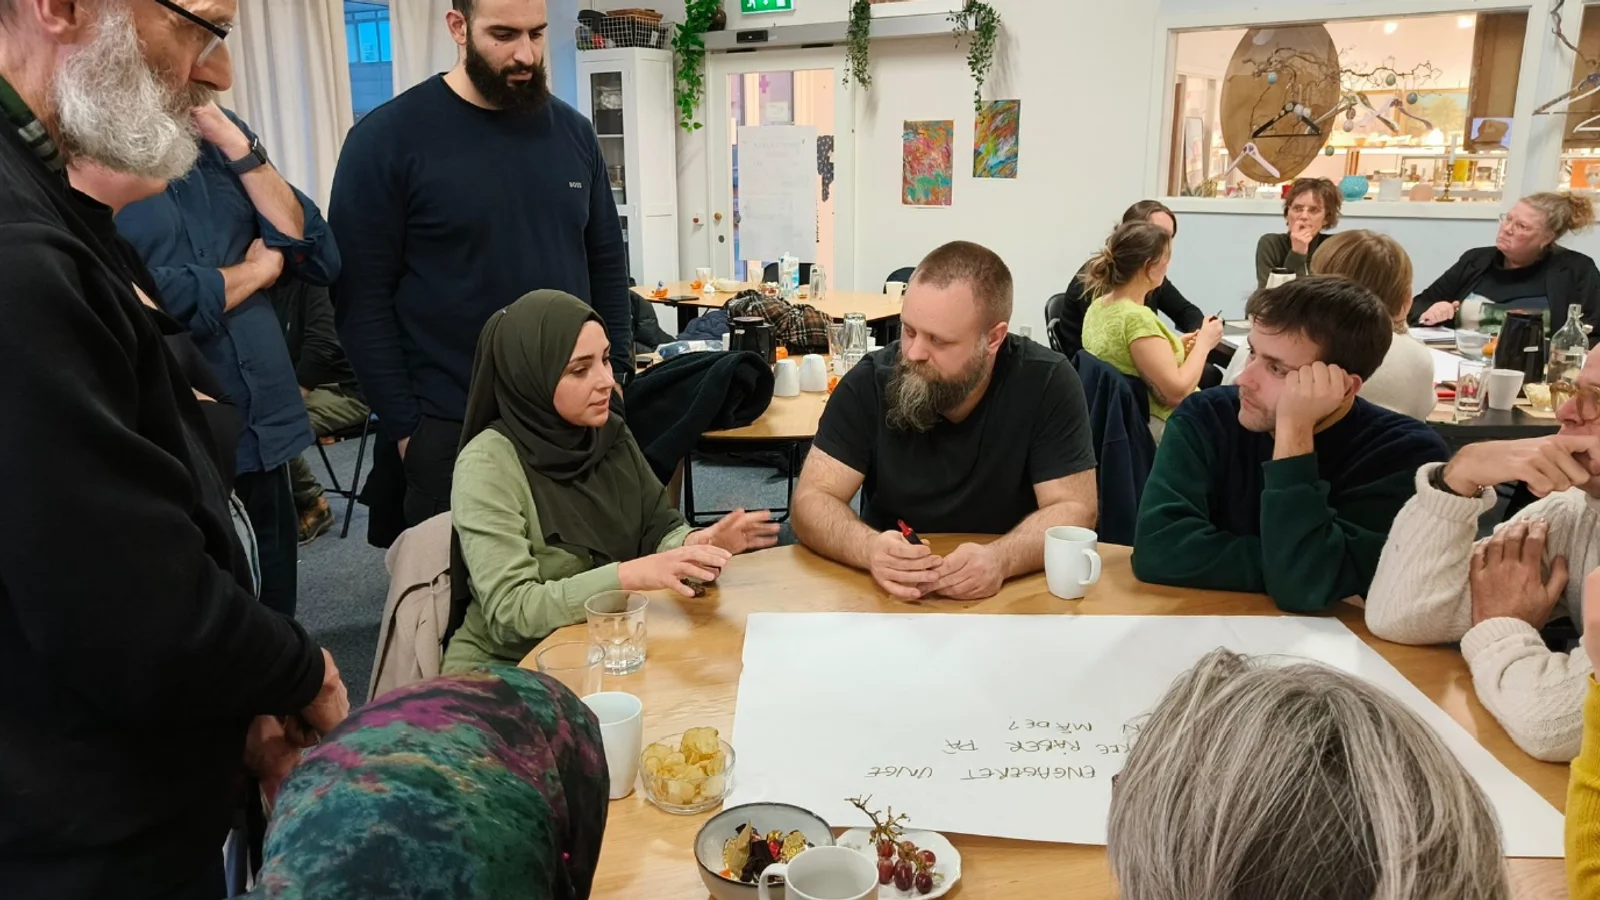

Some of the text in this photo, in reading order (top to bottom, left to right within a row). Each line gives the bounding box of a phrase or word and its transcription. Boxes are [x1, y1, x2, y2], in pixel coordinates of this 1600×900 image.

[942, 739, 979, 755] PÅ
[864, 765, 1096, 780] ENGAGERET UNGE
